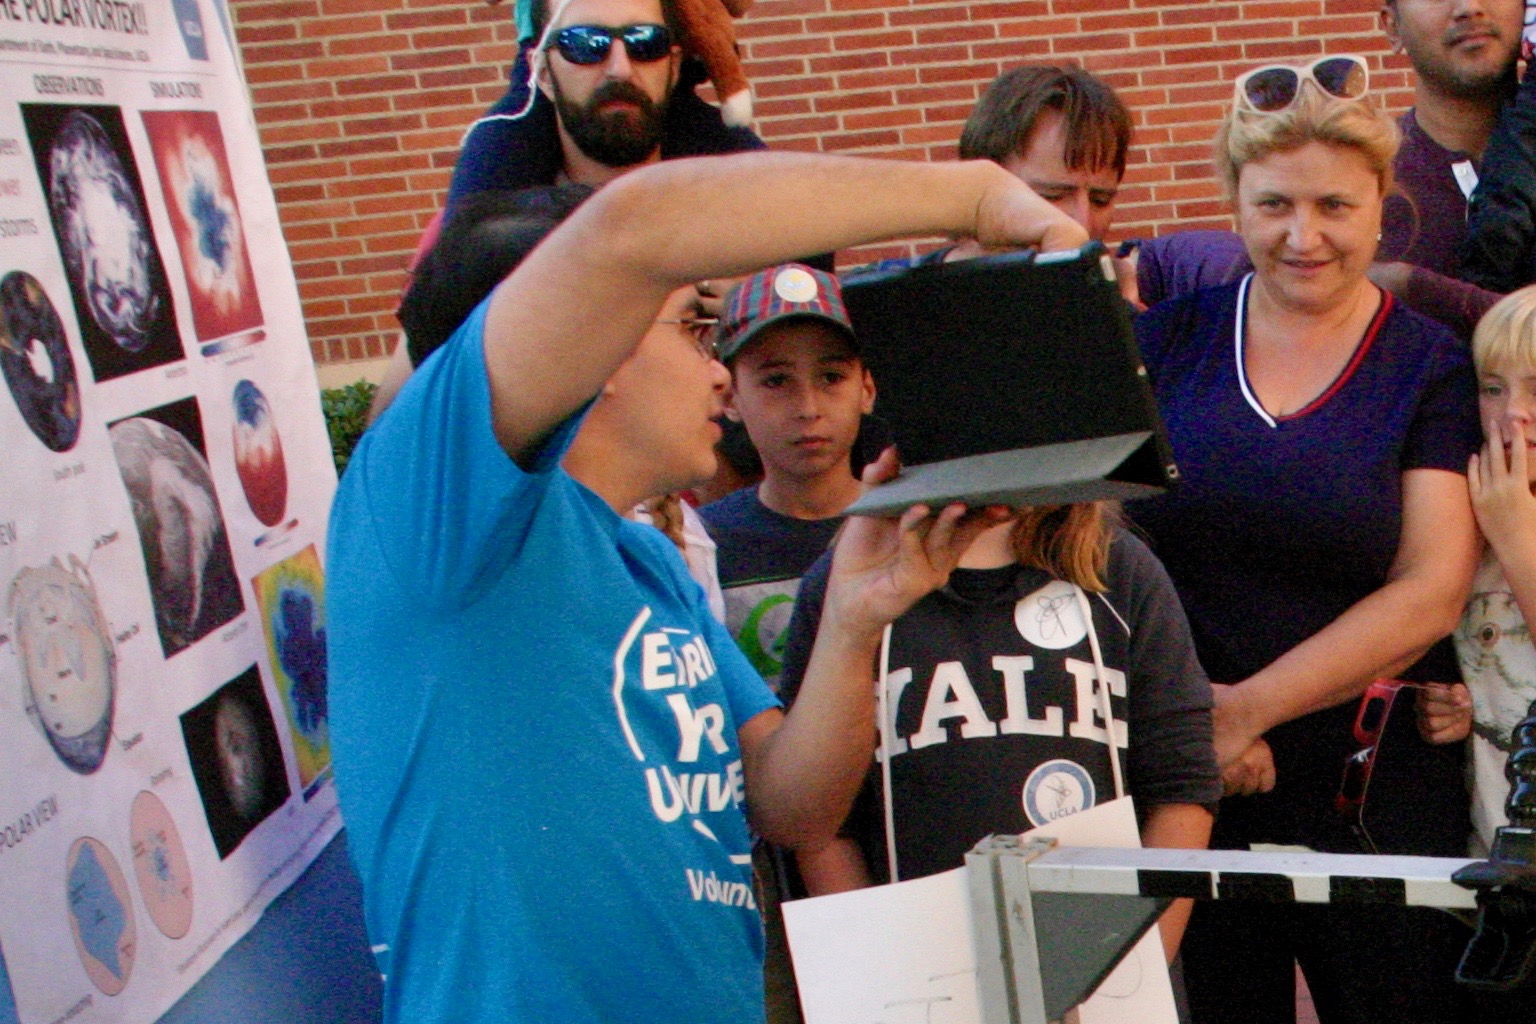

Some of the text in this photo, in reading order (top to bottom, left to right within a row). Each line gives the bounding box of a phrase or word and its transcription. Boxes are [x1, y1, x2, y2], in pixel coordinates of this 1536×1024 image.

[0, 0, 22, 21] HE
[24, 0, 87, 28] POLAR
[875, 655, 1129, 763] YALE
